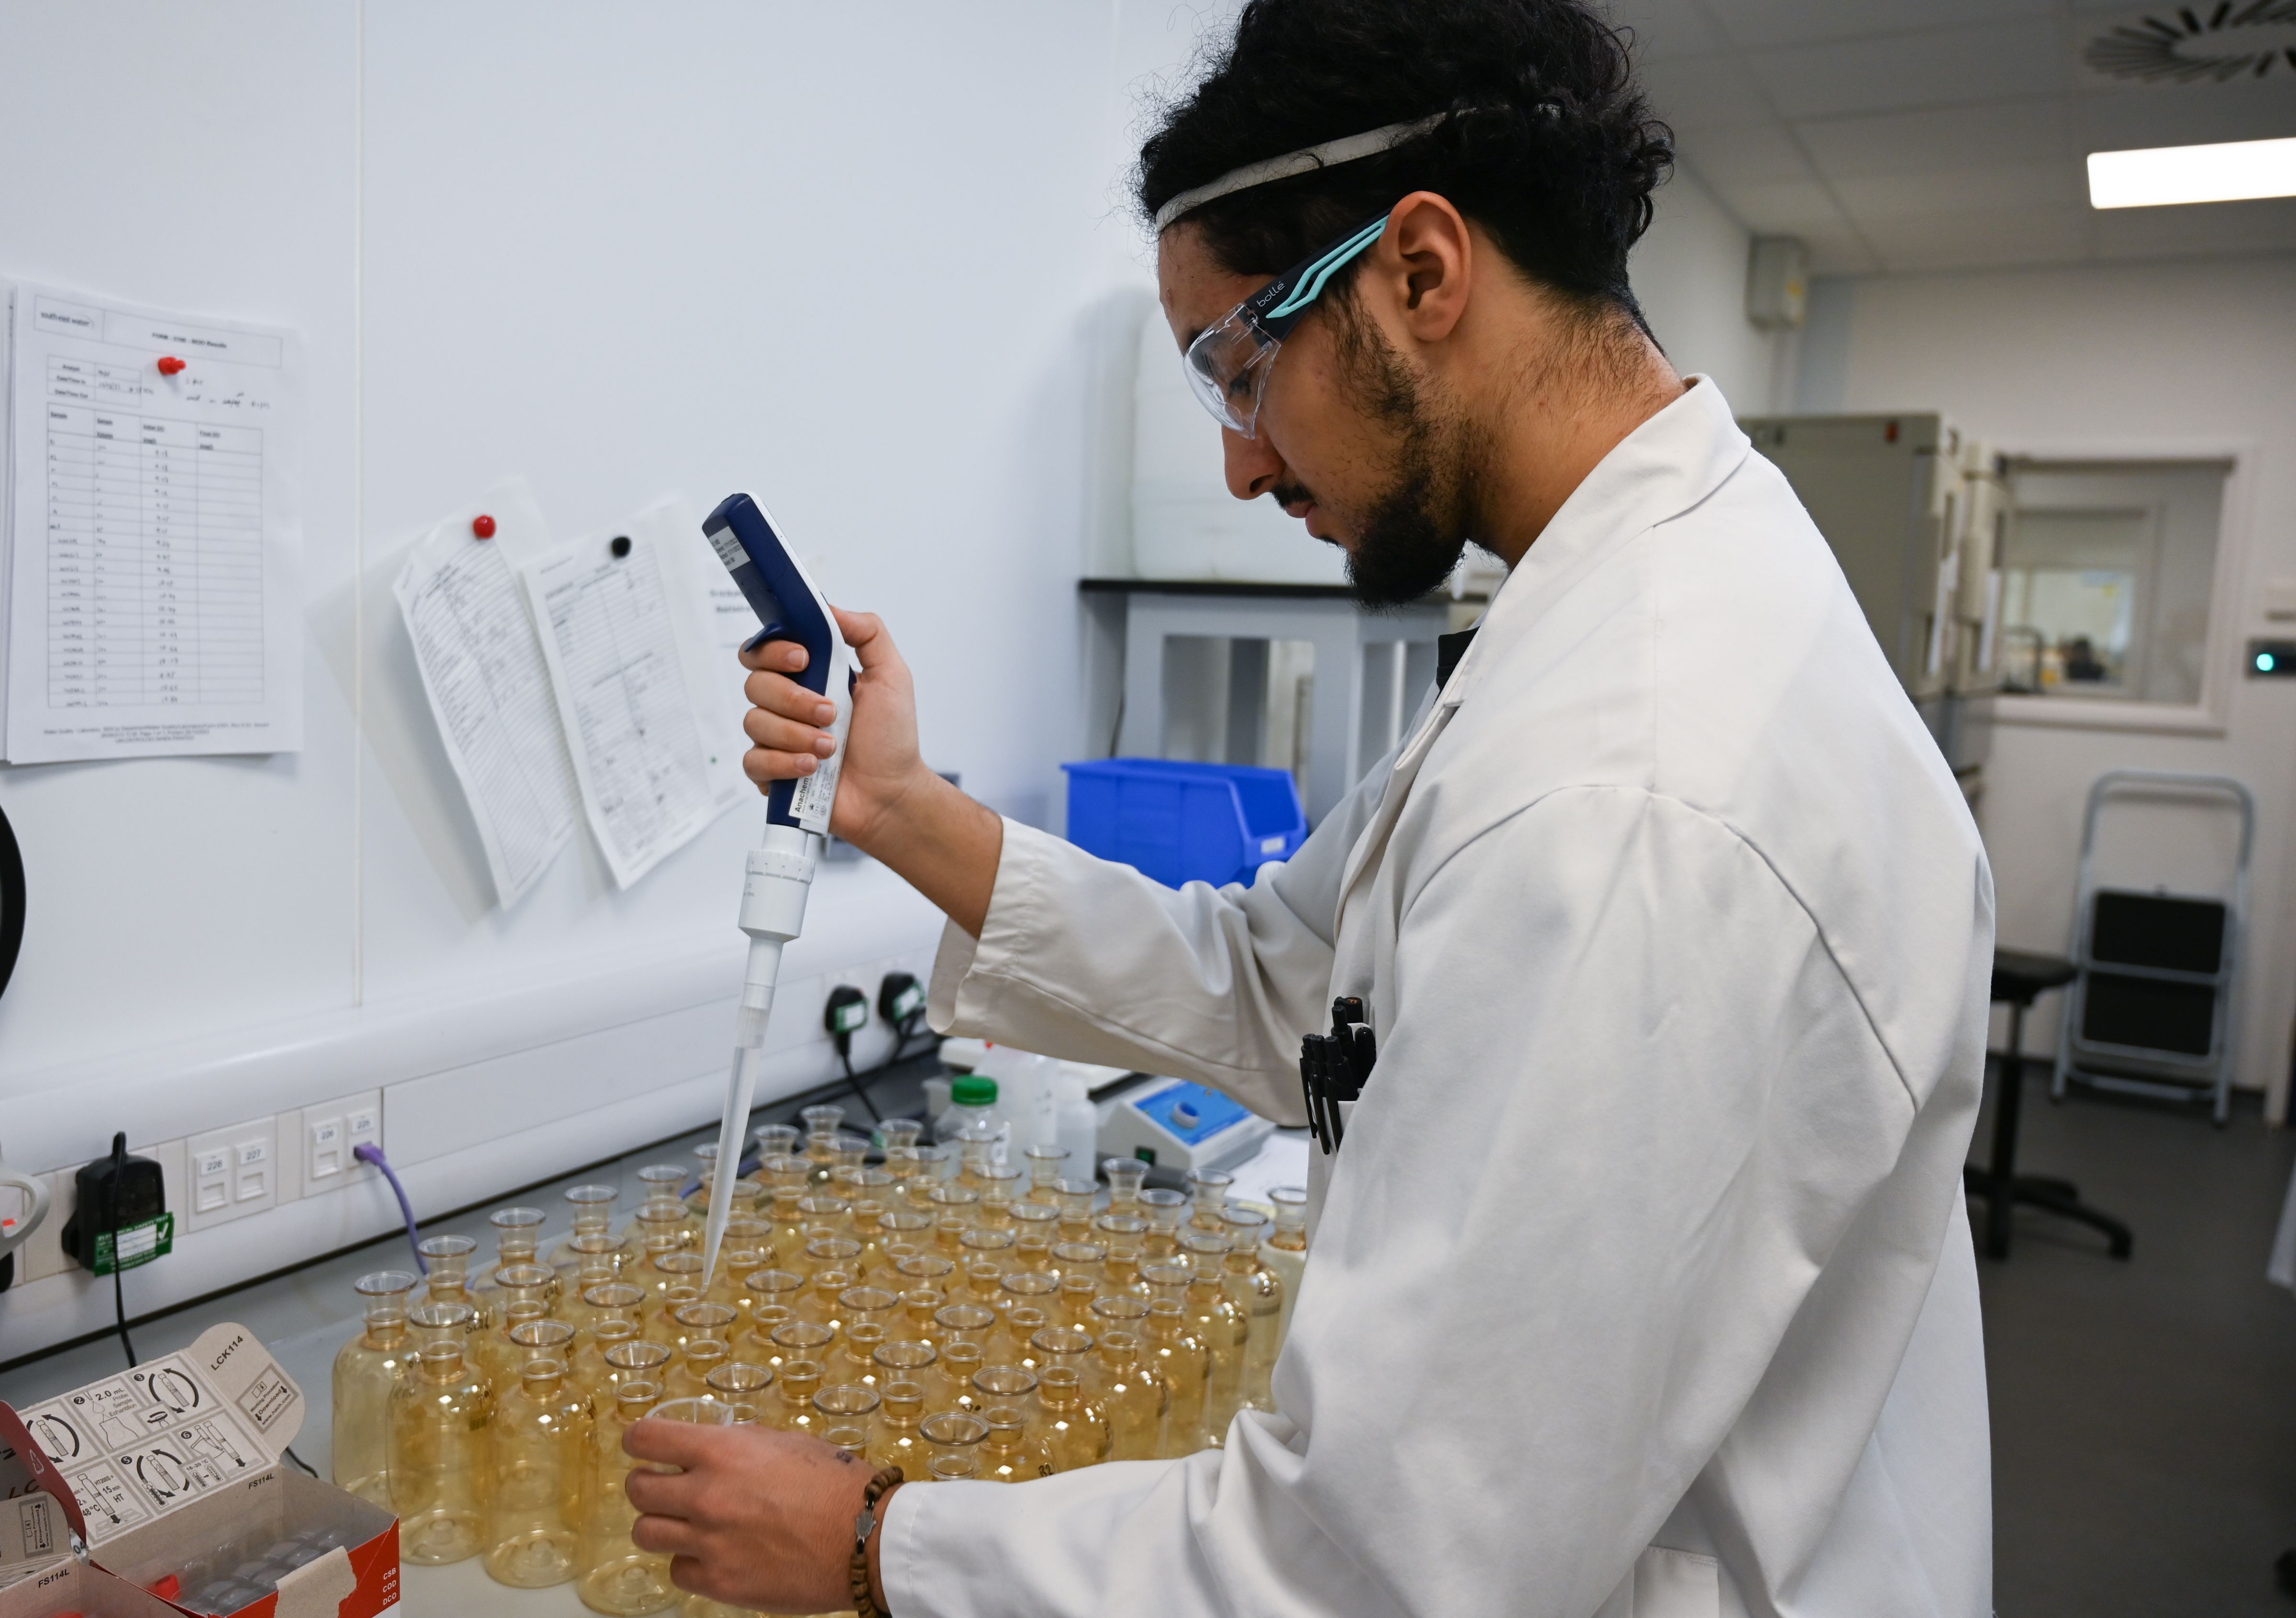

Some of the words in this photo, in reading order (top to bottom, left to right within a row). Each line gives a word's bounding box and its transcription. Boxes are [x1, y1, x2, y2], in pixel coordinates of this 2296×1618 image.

[1256, 281, 1285, 307] bollé
[795, 777, 809, 813] Anachem
[211, 1335, 243, 1371] LCK114
[95, 1390, 112, 1401] 2.0
[112, 1393, 129, 1401] Probe
[113, 1398, 133, 1408] Sample
[250, 1398, 265, 1412] Working
[263, 1381, 280, 1398] Procedure
[258, 1389, 282, 1415] Download
[262, 1393, 291, 1425] www.hach.com
[249, 1473, 275, 1489] FS114L
[103, 1486, 112, 1494] 15
[113, 1493, 124, 1503] HT
[38, 1569, 70, 1588] FS114L
[383, 1567, 396, 1580] CSB
[383, 1580, 397, 1593] COD
[383, 1592, 397, 1606] DCO
